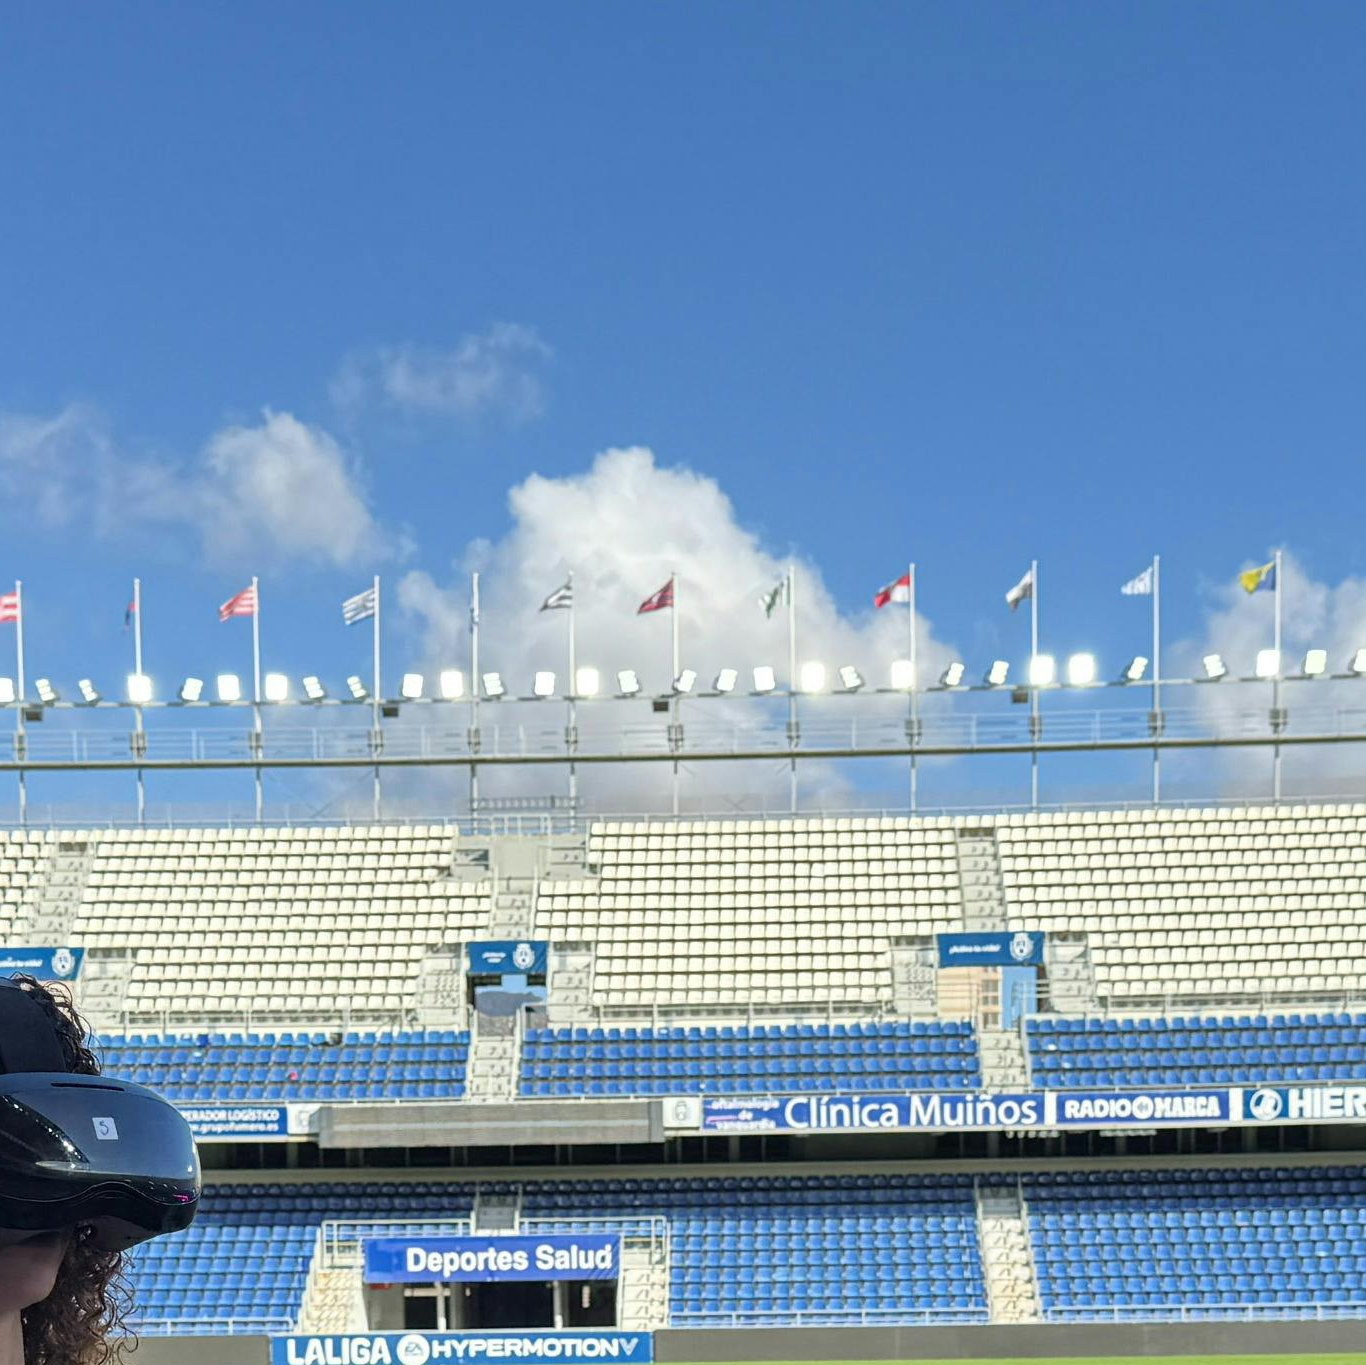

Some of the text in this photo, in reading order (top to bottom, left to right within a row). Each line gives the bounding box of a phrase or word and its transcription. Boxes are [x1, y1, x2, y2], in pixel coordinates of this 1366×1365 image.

[785, 1095, 1037, 1128] Clínica Muiños
[1065, 1096, 1221, 1118] RADIO MARCA
[99, 1120, 109, 1136] 5
[406, 1244, 612, 1277] Deportes Salud
[287, 1337, 392, 1365] LALIGA
